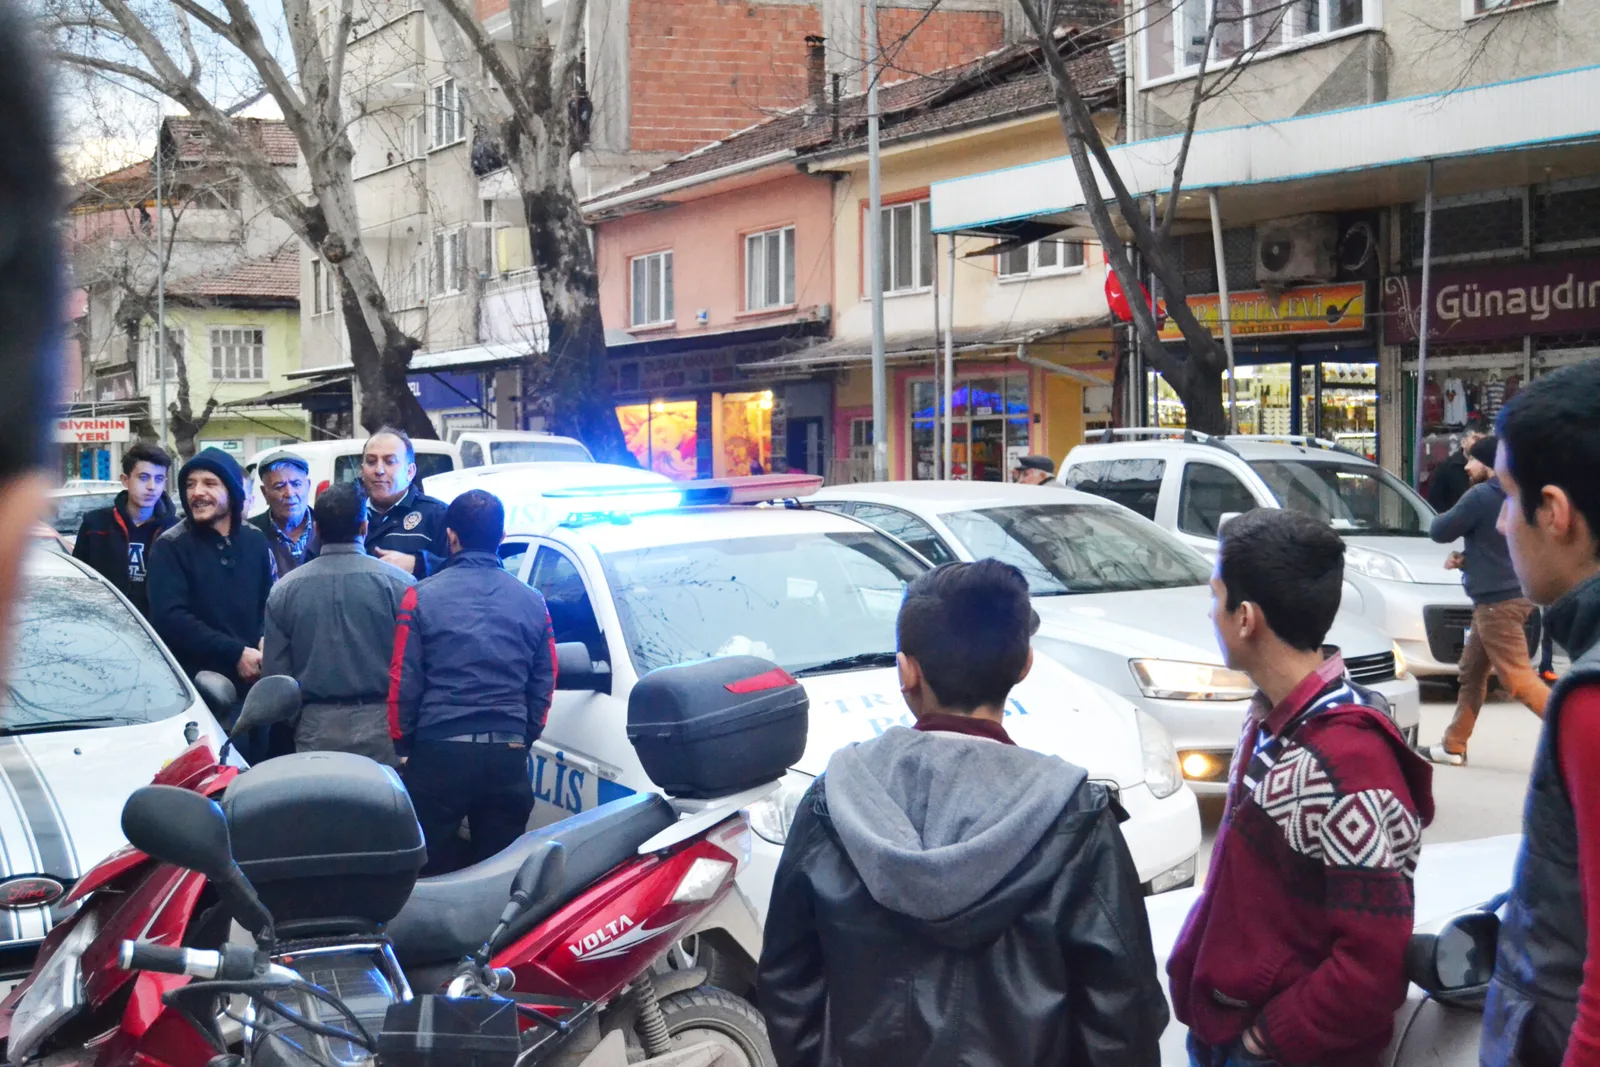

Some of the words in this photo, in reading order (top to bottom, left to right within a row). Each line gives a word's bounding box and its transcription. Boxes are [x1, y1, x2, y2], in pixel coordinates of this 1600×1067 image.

[75, 430, 110, 441] YERİ
[526, 750, 585, 814] LİS
[8, 883, 47, 900] Ford
[568, 914, 634, 957] VOLTA
